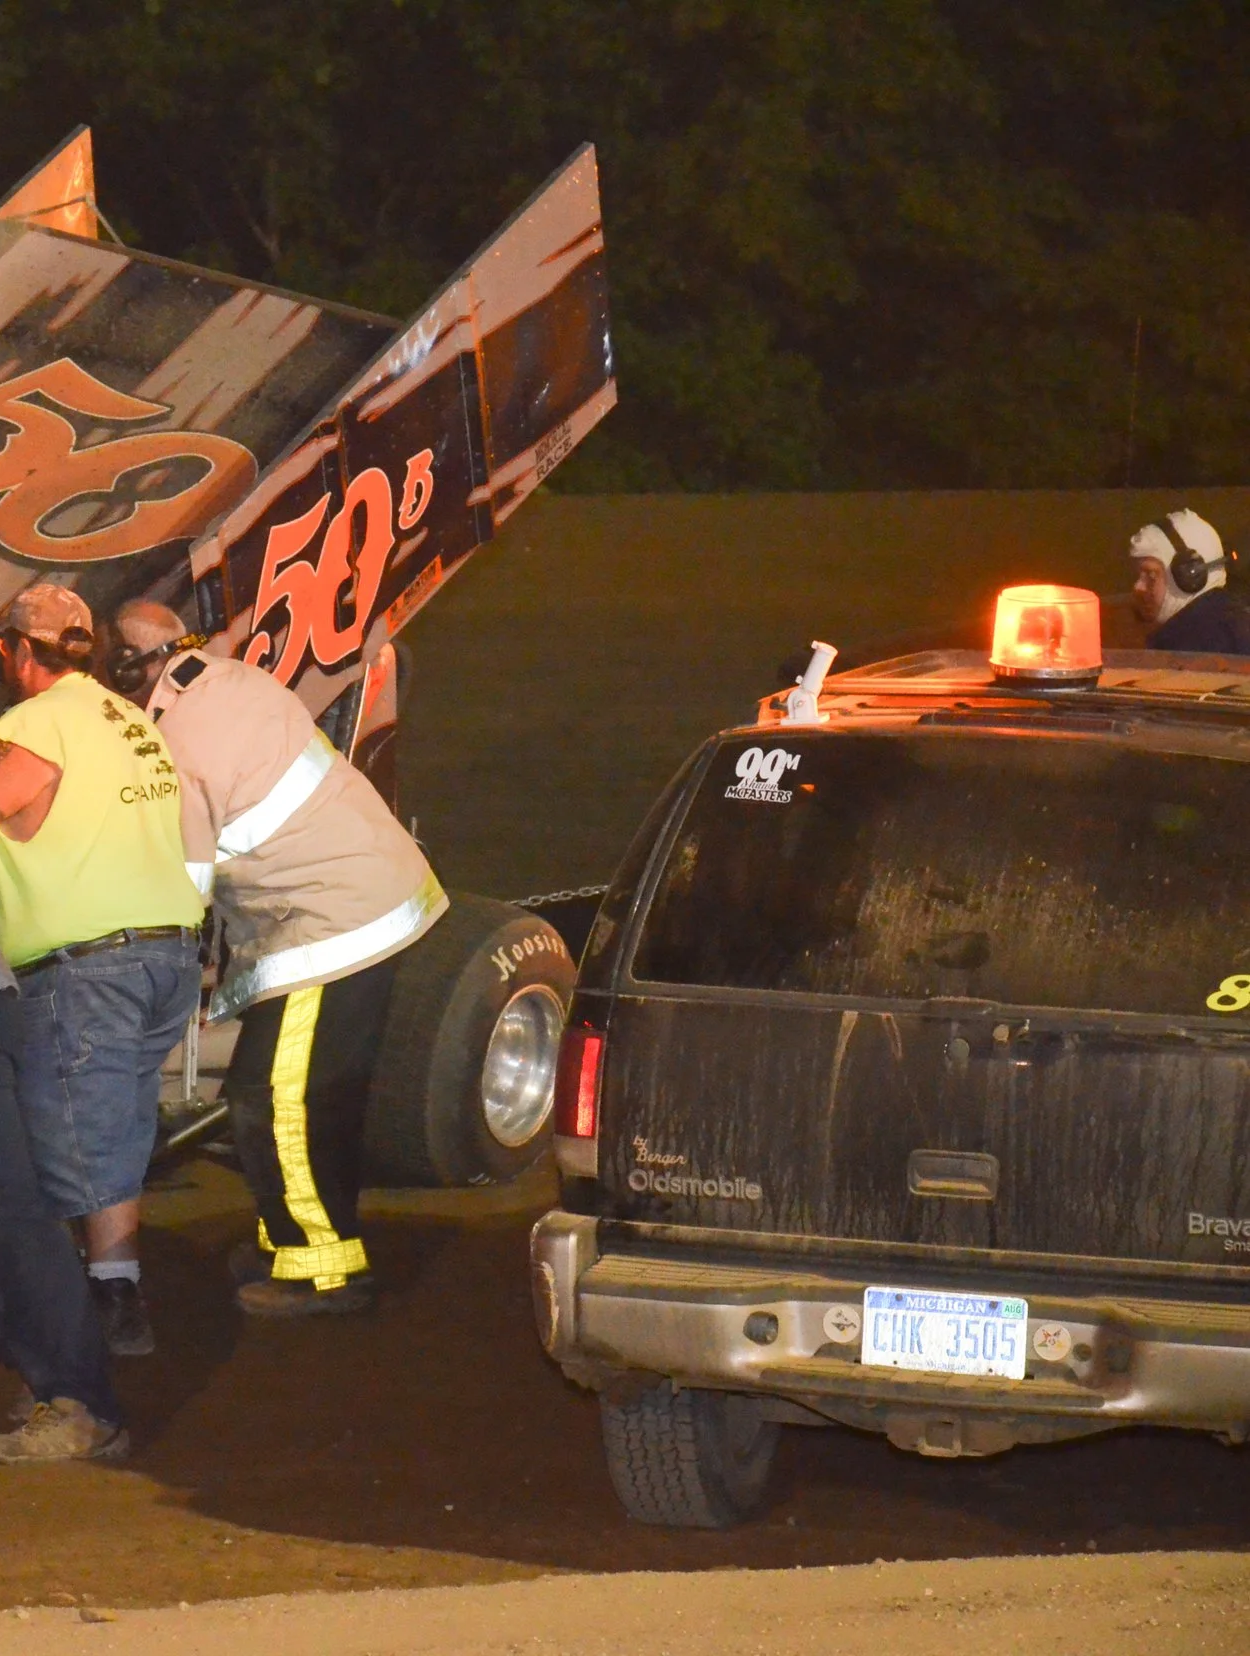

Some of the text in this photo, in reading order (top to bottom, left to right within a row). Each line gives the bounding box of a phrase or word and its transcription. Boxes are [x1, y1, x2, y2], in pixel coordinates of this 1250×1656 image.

[633, 1134, 648, 1149] by
[636, 1146, 687, 1165] Berger
[628, 1168, 763, 1200] Oldsmobile
[906, 1294, 986, 1314] MICHIGAN
[1004, 1304, 1022, 1315] AUG
[872, 1311, 1017, 1363] CHK 3505
